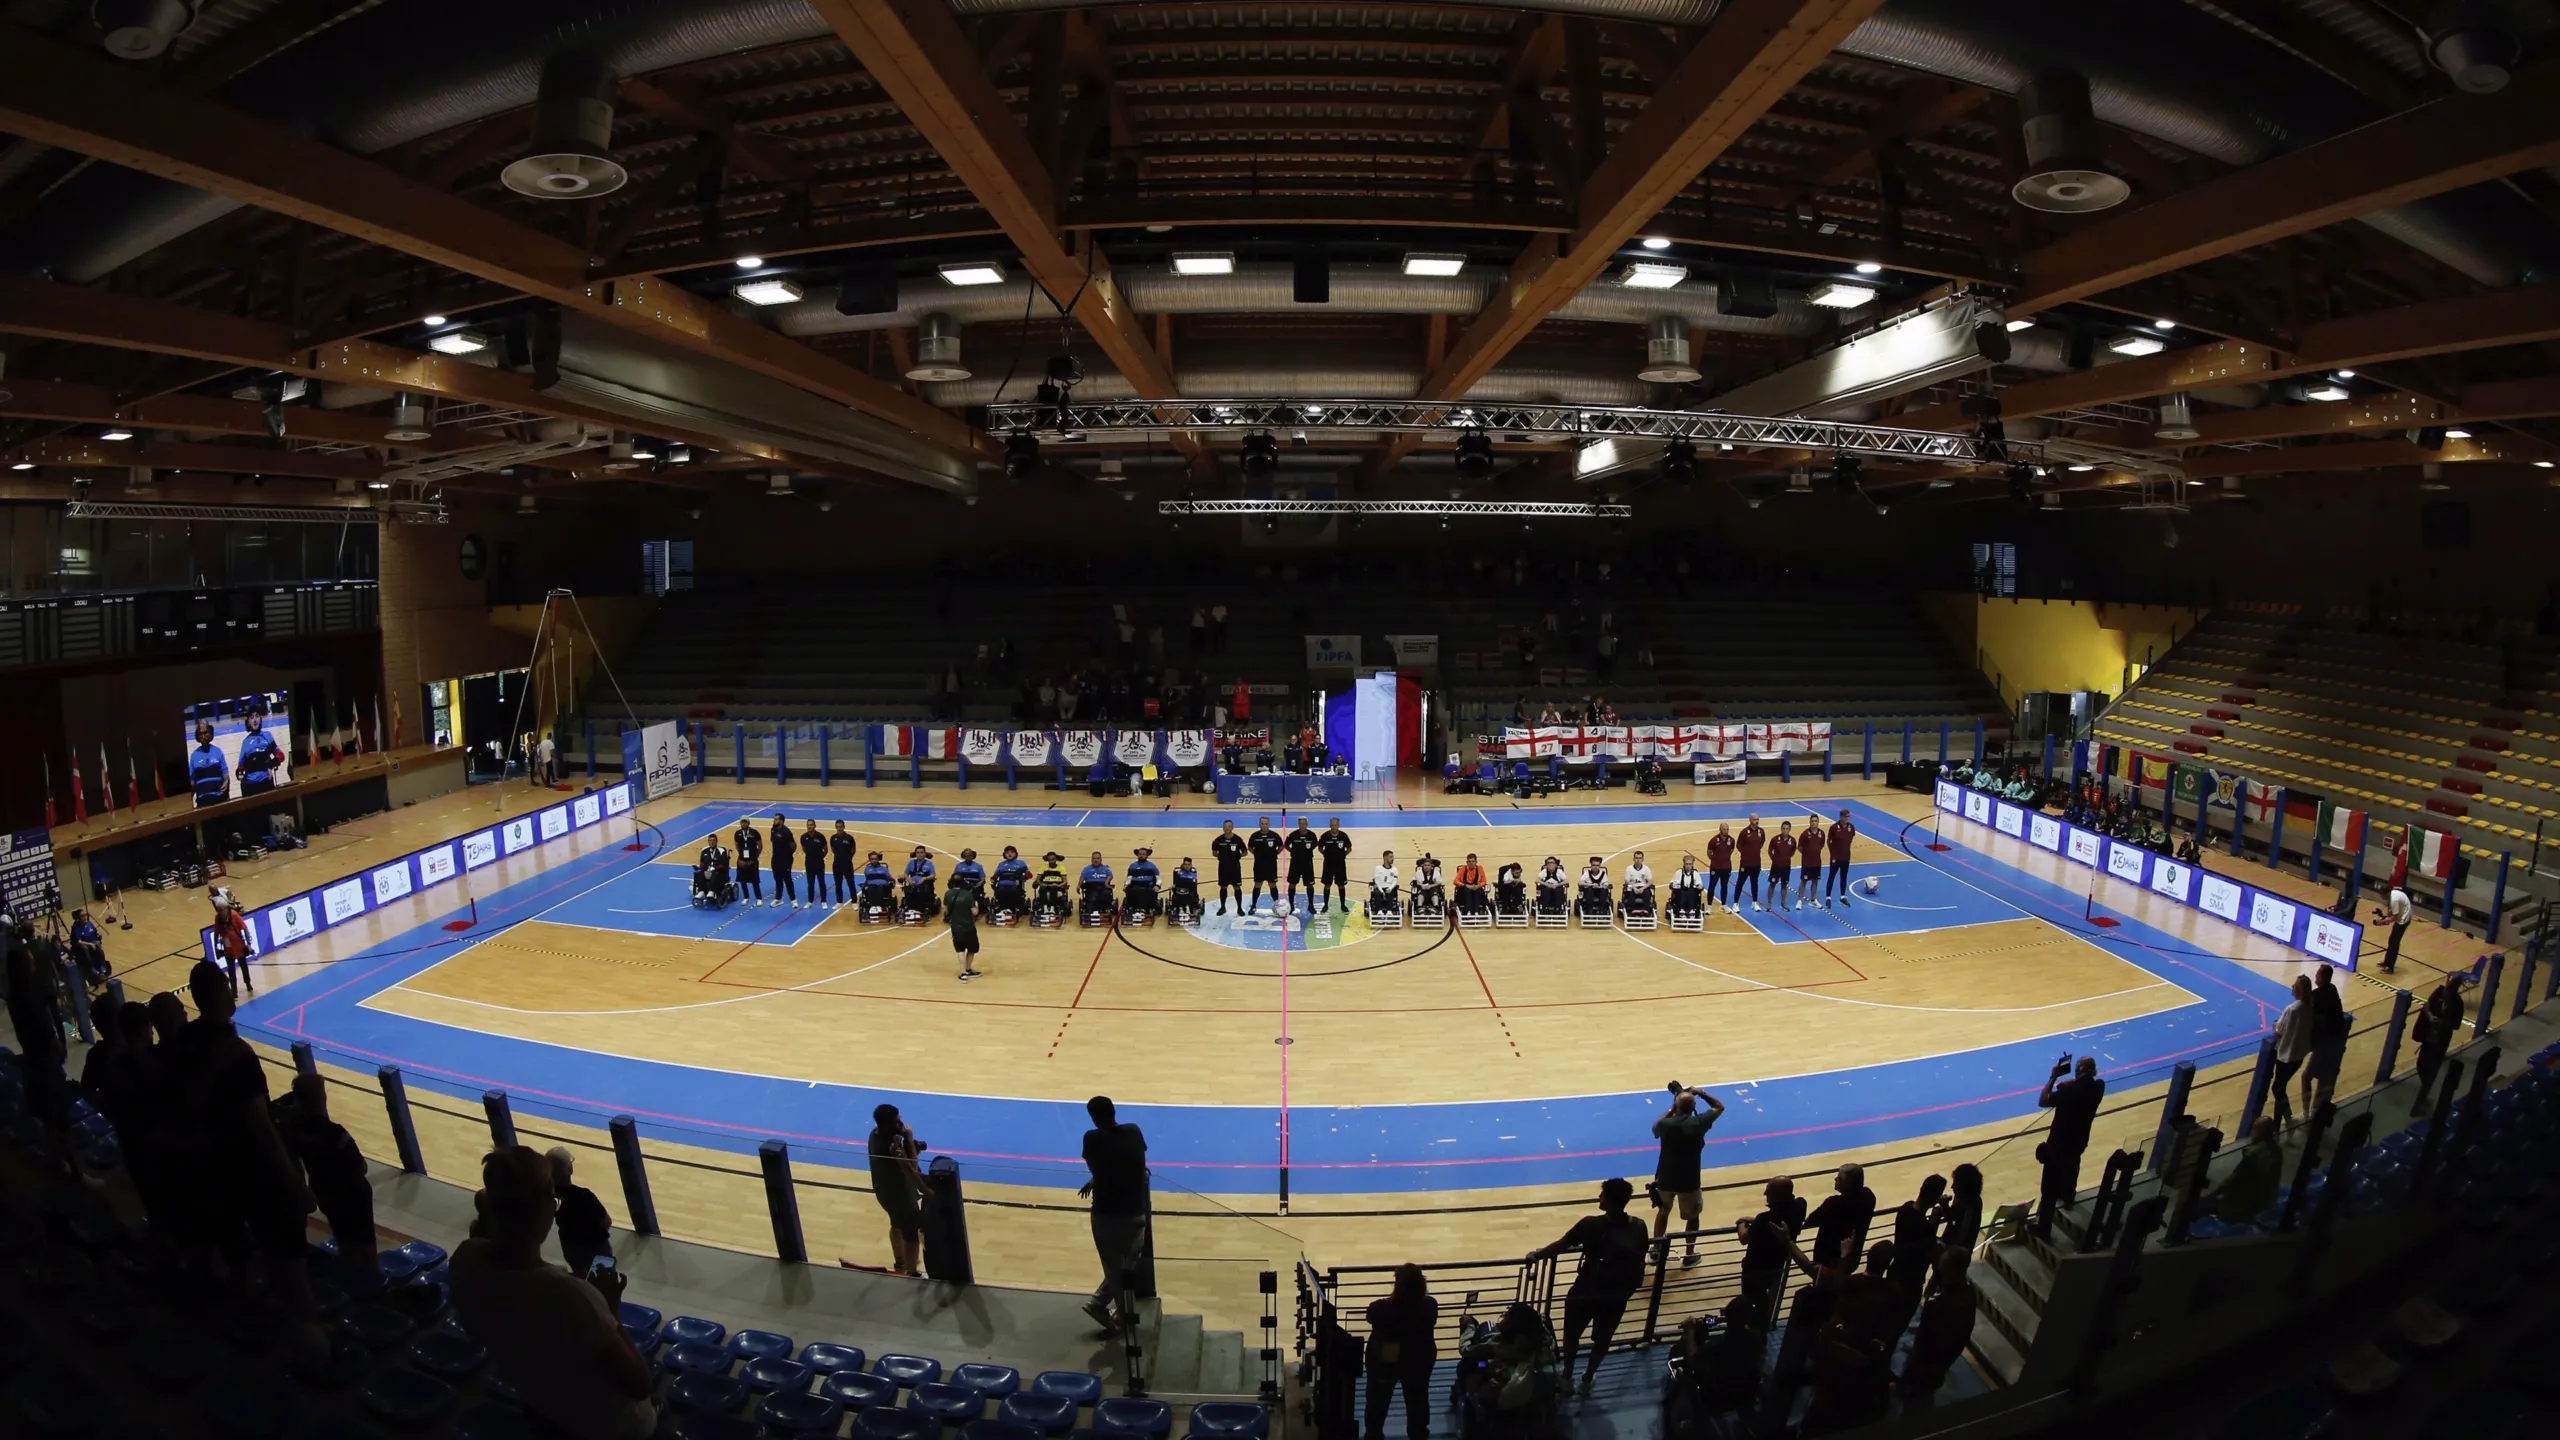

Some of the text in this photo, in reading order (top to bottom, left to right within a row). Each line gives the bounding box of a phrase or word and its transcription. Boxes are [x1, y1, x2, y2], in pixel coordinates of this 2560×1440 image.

[1316, 651, 1354, 662] FIPFA
[1541, 743, 1554, 753] 27
[1591, 743, 1598, 754] 8
[1686, 742, 1693, 752] 7
[649, 764, 679, 782] FIPPS
[1236, 797, 1263, 805] EPFA
[335, 904, 352, 917] SMA
[2209, 898, 2225, 912] SMA
